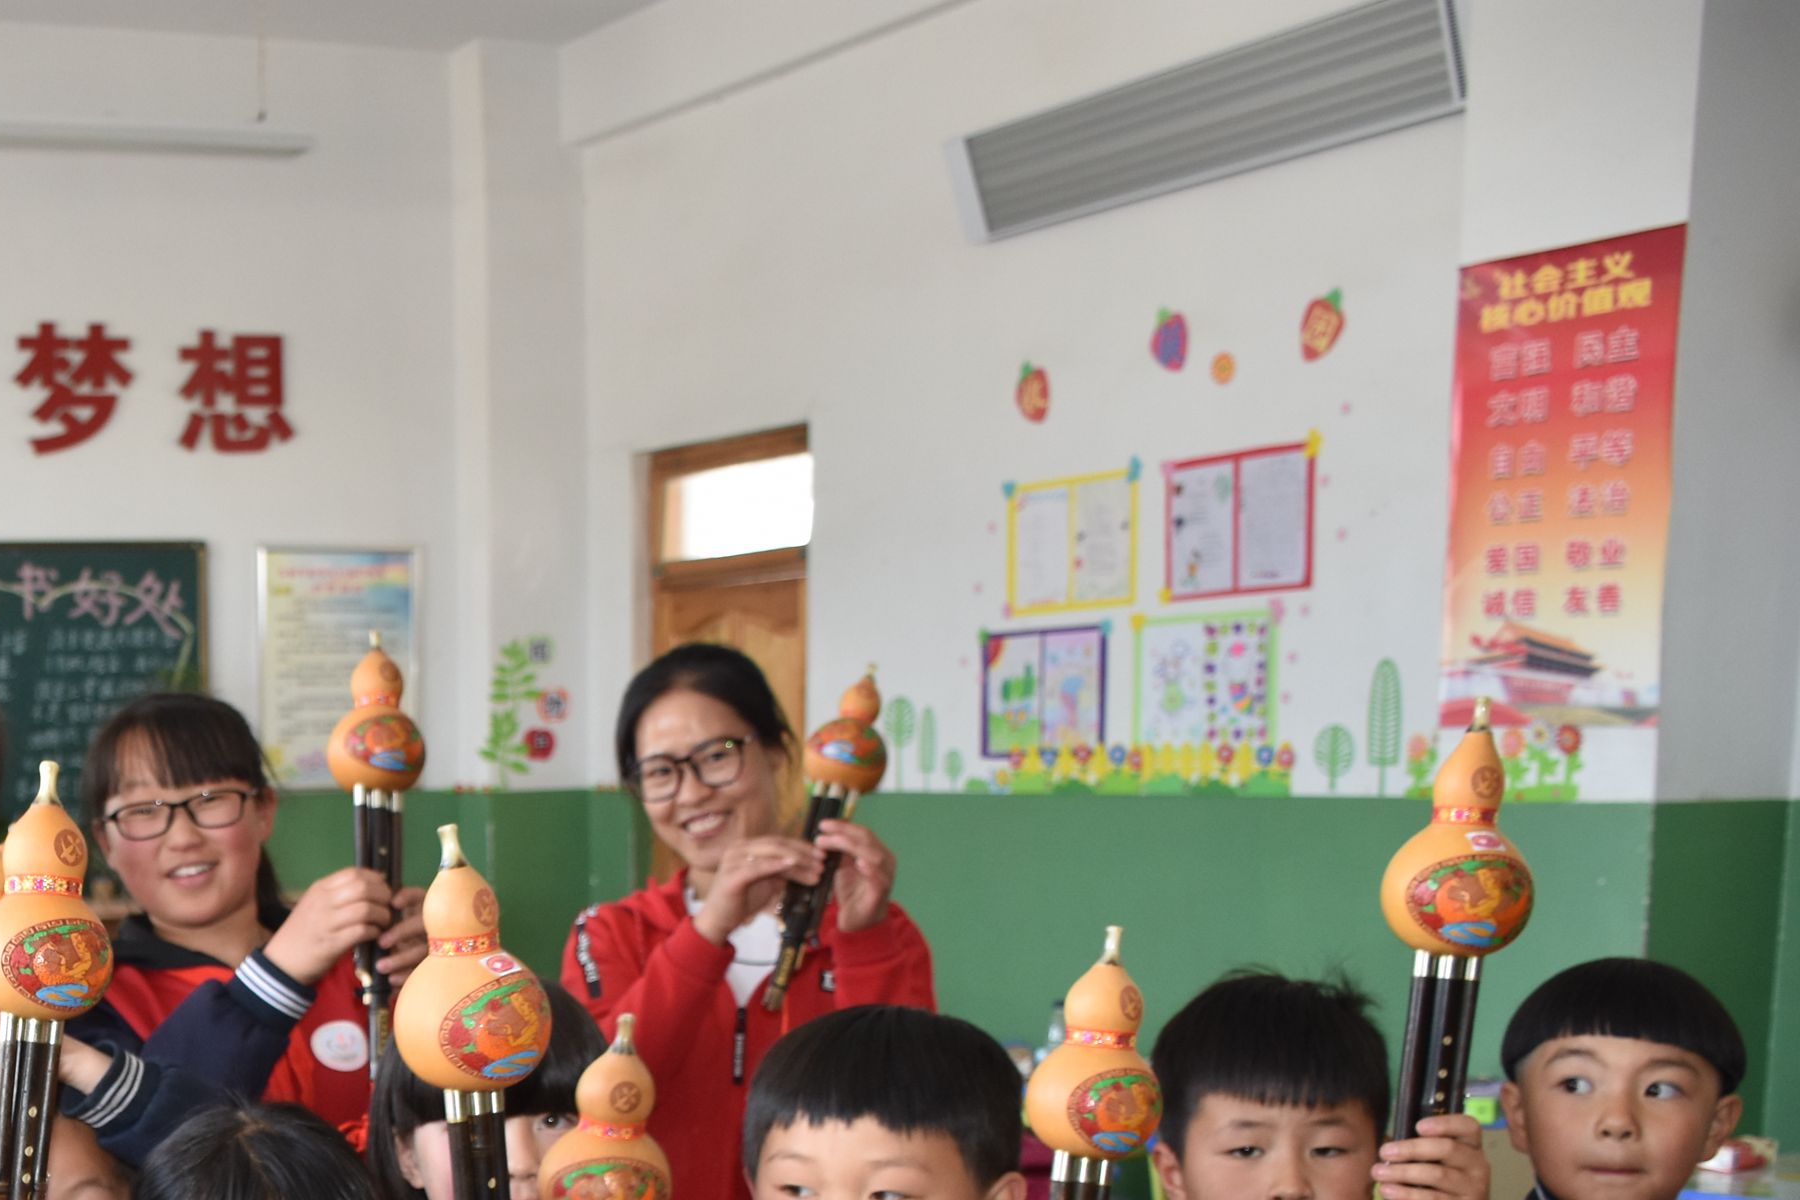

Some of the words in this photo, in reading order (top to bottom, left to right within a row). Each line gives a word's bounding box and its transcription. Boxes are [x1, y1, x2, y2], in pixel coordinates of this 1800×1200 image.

[1497, 250, 1636, 300] 社会主义
[1480, 278, 1654, 333] 核心价值观
[1489, 338, 1552, 382] 富强
[1573, 326, 1641, 369] 民主
[1486, 385, 1549, 428] 文明
[1571, 374, 1638, 416] 和谐
[1489, 440, 1547, 480] 自由
[1568, 429, 1636, 471] 平等
[1486, 490, 1544, 525] 公正
[1567, 479, 1632, 517] 法治
[1485, 544, 1540, 575] 爱国
[1566, 538, 1626, 569] 敬业
[1483, 587, 1539, 618] 诚信
[1564, 583, 1622, 616] 友善
